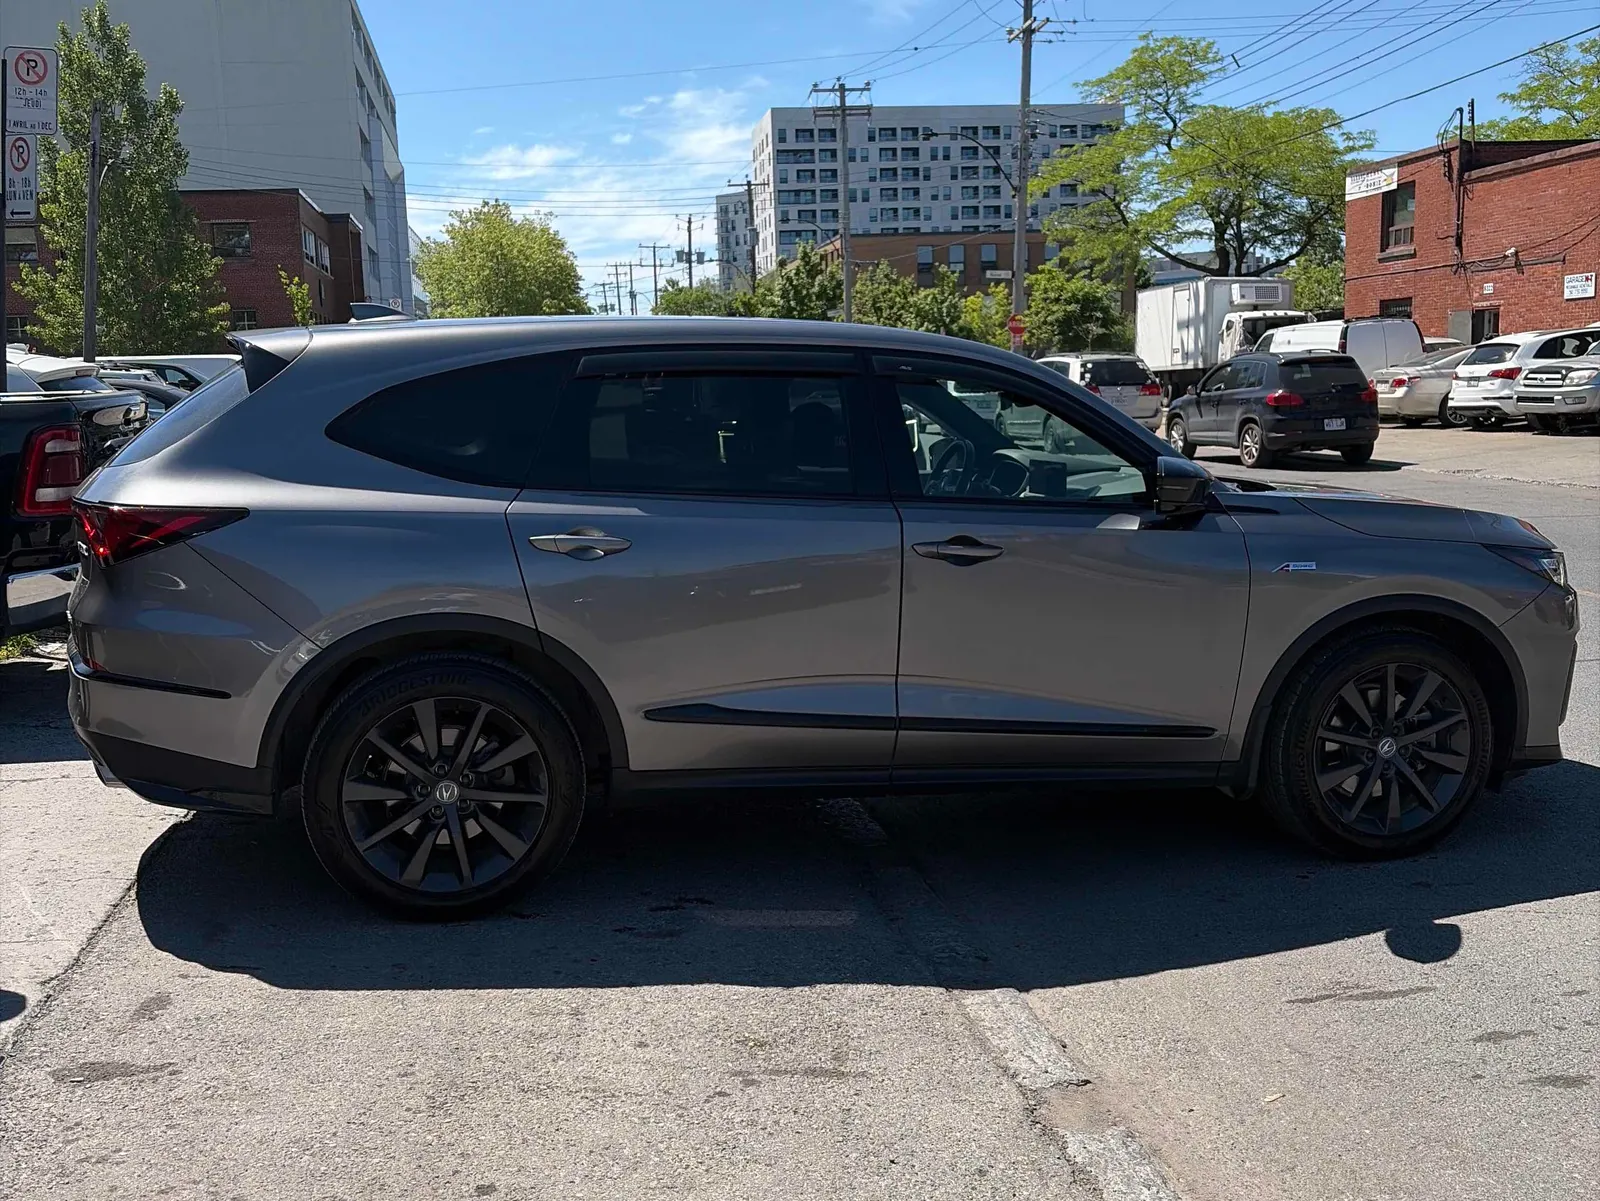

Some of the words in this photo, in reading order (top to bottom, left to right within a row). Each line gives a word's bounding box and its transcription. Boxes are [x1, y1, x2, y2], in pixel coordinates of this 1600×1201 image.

[14, 87, 26, 95] 12h
[35, 88, 48, 97] 14h
[23, 99, 42, 108] JEUDI
[13, 121, 28, 129] AVRIL
[21, 176, 31, 188] 18h
[6, 189, 17, 200] LUN
[22, 189, 34, 200] VEN
